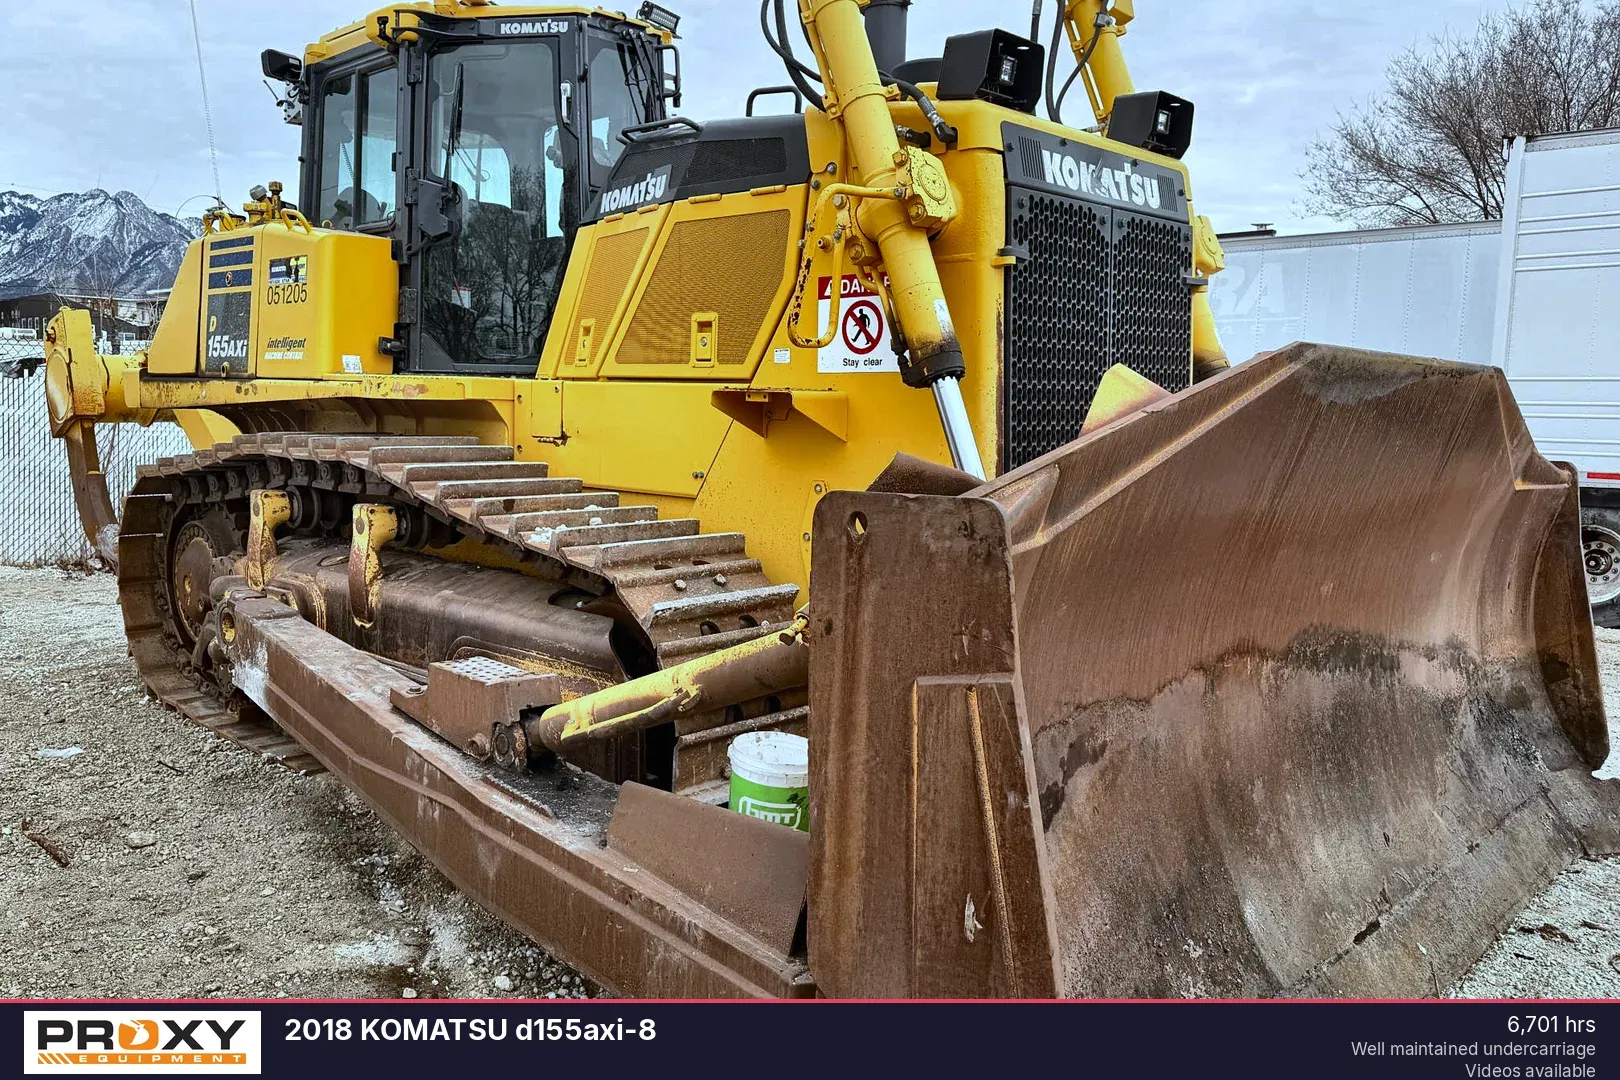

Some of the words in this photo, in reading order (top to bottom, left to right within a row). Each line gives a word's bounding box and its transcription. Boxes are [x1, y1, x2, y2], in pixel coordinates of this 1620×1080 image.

[500, 19, 568, 34] KOMATSU
[600, 173, 667, 214] KOMATSU
[267, 283, 307, 305] 051205
[209, 316, 217, 332] D
[208, 335, 248, 357] 155AXi
[267, 336, 307, 351] intelligent
[842, 357, 859, 369] Stay
[863, 357, 883, 367] clear
